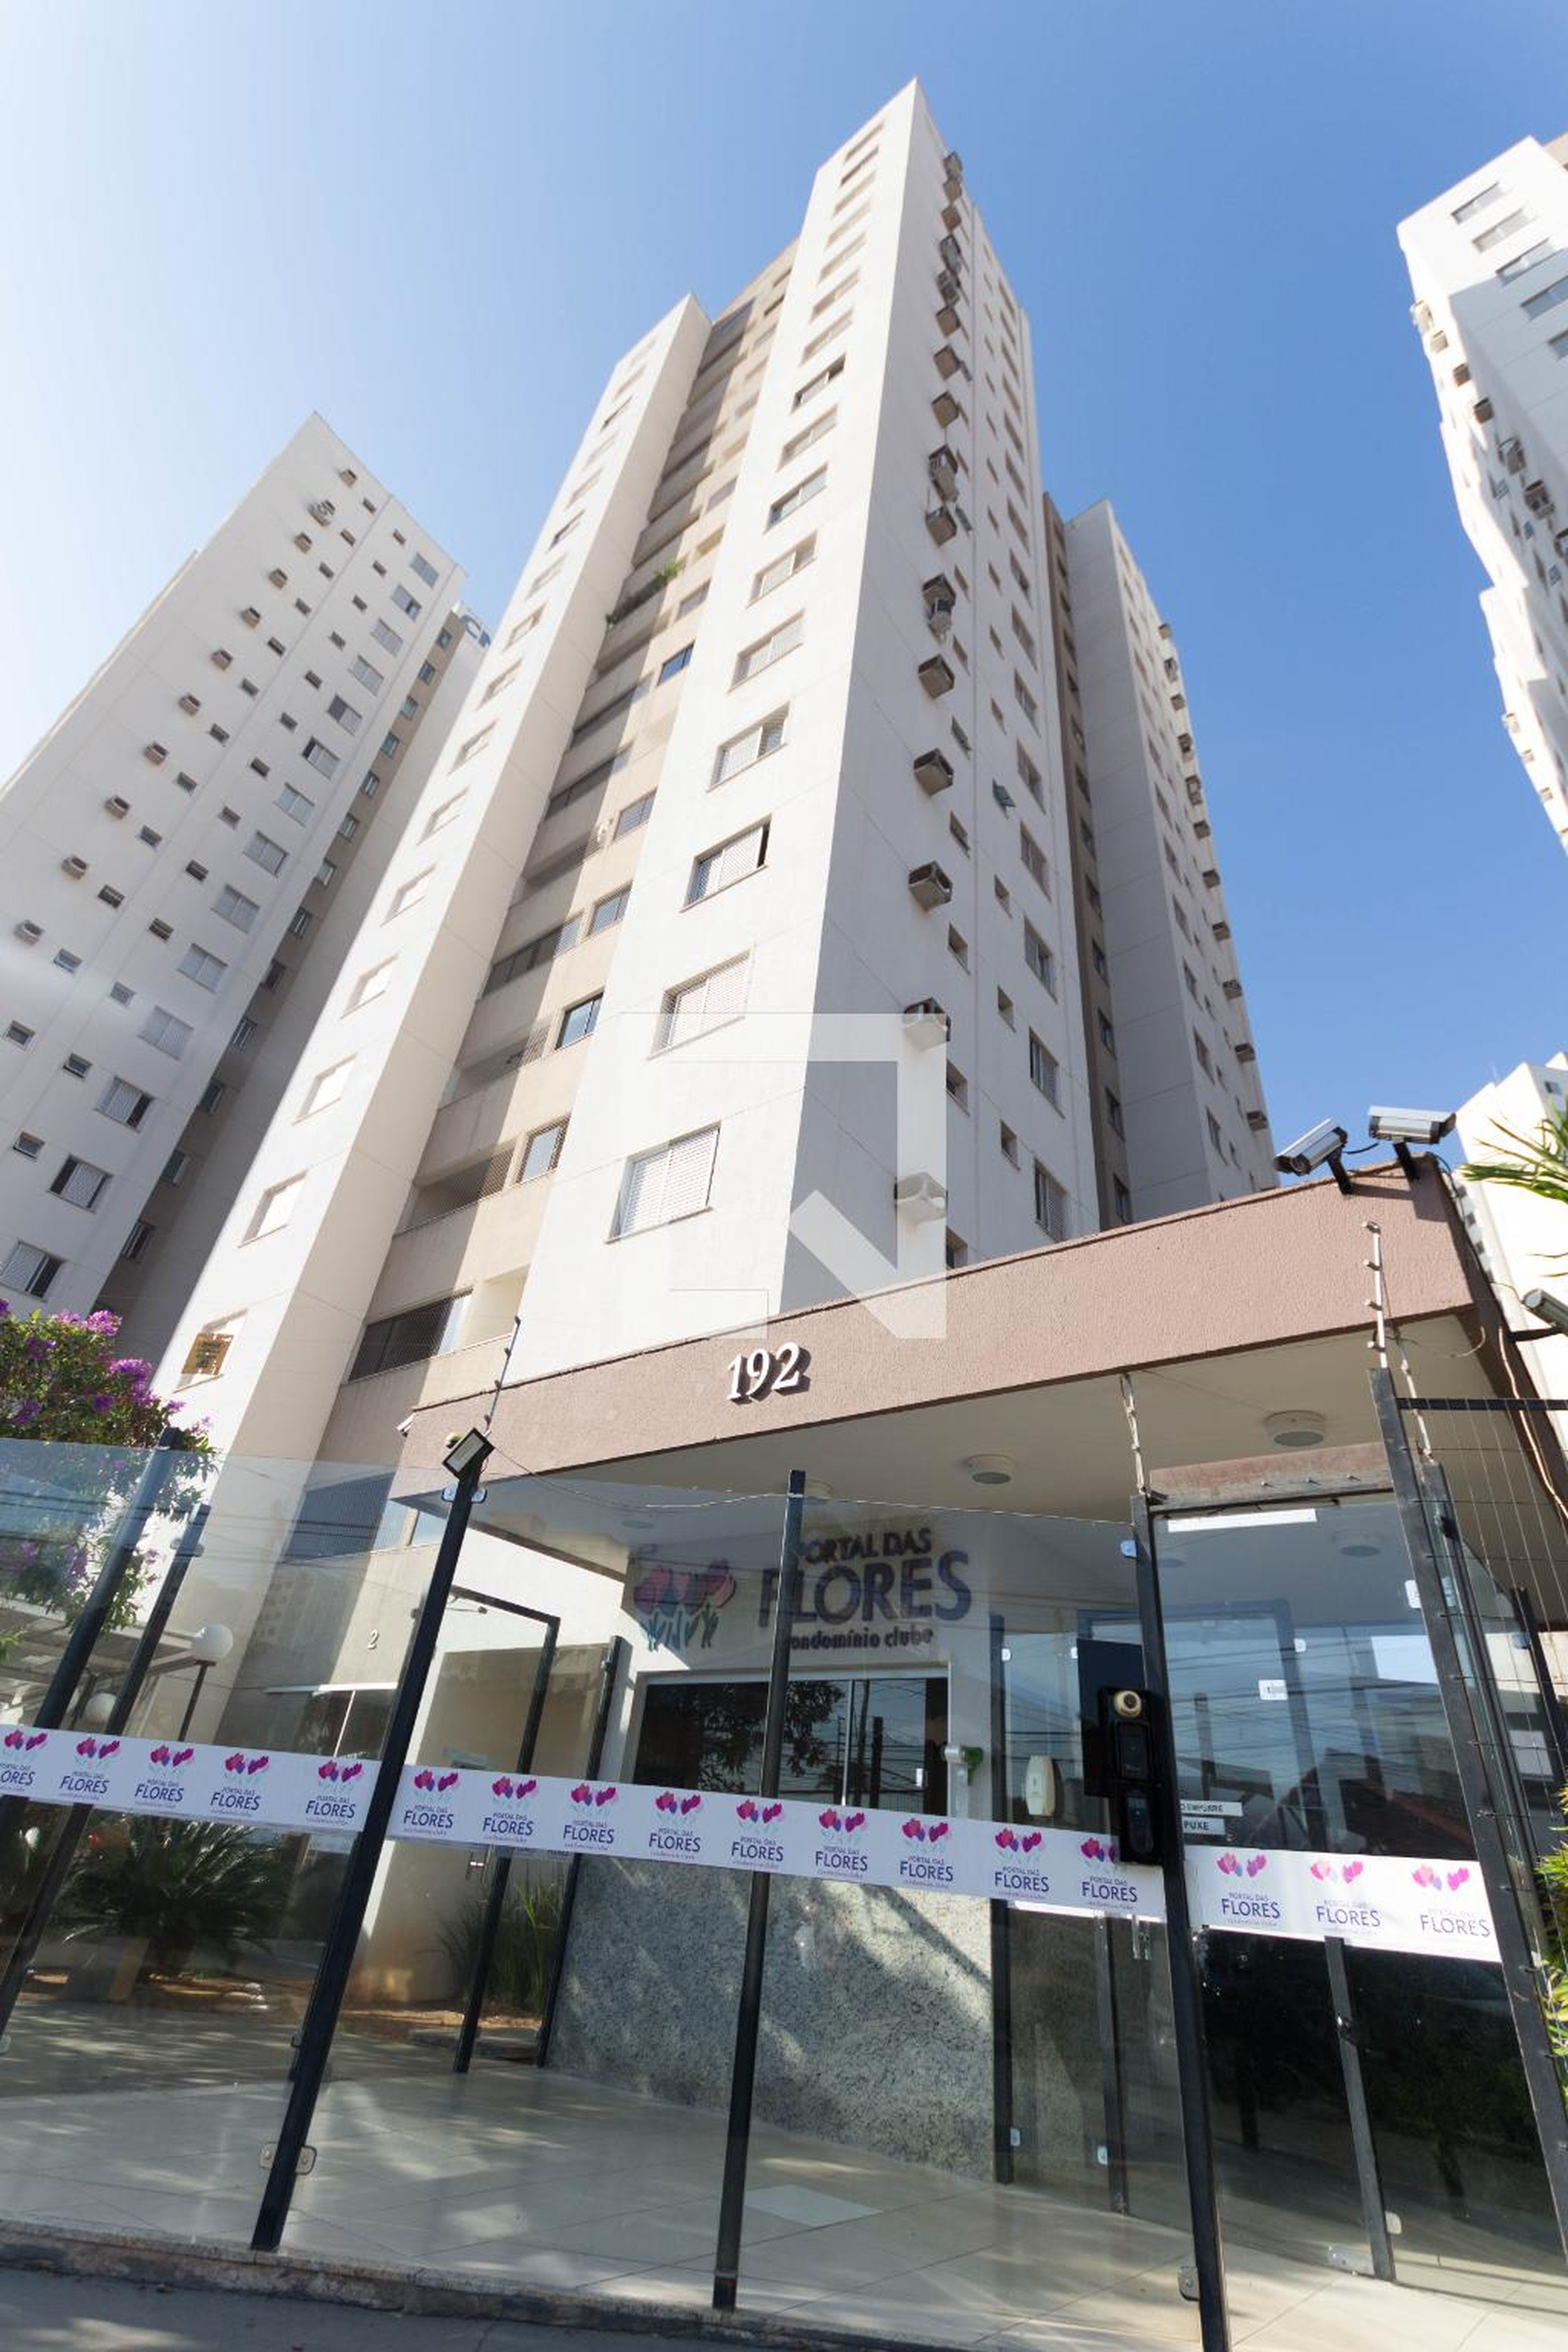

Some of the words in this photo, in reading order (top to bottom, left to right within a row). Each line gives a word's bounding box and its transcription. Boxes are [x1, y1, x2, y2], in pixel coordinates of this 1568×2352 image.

[726, 1341, 805, 1401] 192
[884, 1528, 932, 1555] DAS
[759, 1550, 972, 1628] FLORES
[368, 1629, 379, 1649] 2
[789, 1626, 880, 1649] ondomínio
[884, 1624, 933, 1648] clube
[0, 1770, 36, 1786] ORES
[60, 1776, 109, 1794] FLORES
[134, 1784, 184, 1802] FLORES
[210, 1793, 262, 1811] FLORES
[306, 1800, 356, 1818] FLORES
[403, 1811, 454, 1829] FLORES
[483, 1817, 534, 1836] FLORES
[1183, 1820, 1209, 1830] PUXE
[563, 1824, 615, 1844] FLORES
[649, 1833, 701, 1852] FLORES
[732, 1842, 784, 1861] FLORES
[815, 1851, 868, 1872] FLORES
[900, 1861, 953, 1881] FLORES
[995, 1872, 1049, 1892] FLORES
[1082, 1882, 1138, 1902] FLORES
[1222, 1899, 1281, 1919] FLORES
[1316, 1906, 1381, 1927] FLORES
[1420, 1915, 1490, 1938] FLORES
